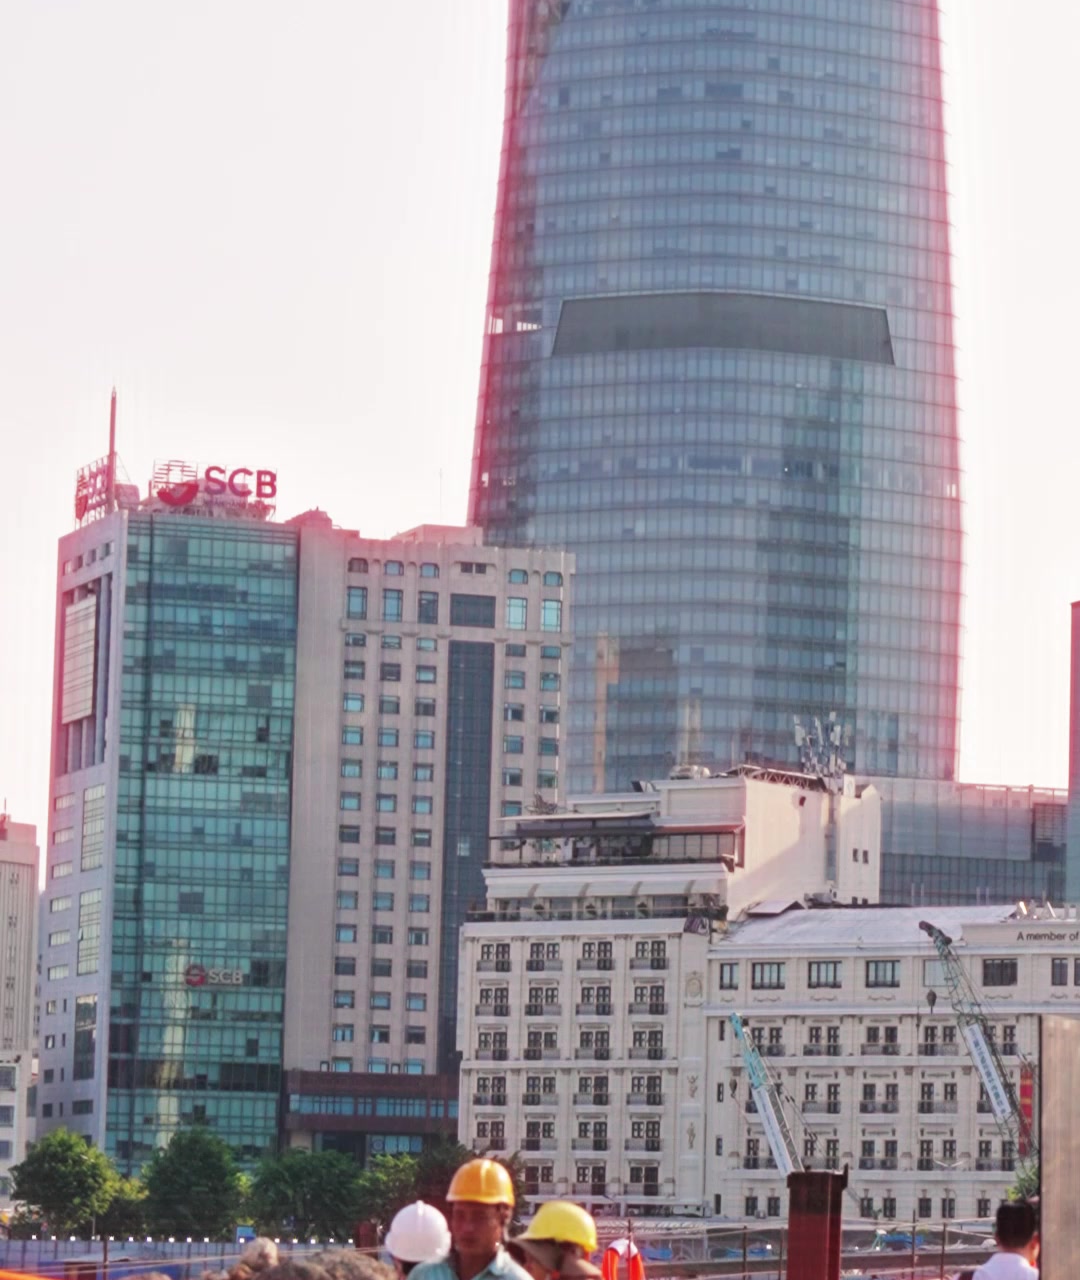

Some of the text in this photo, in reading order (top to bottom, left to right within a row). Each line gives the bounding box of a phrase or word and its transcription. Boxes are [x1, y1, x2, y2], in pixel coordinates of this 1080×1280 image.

[204, 465, 277, 499] SCB
[1016, 930, 1025, 941] A
[1026, 930, 1067, 941] member
[1068, 930, 1080, 941] of
[208, 968, 243, 985] SCB
